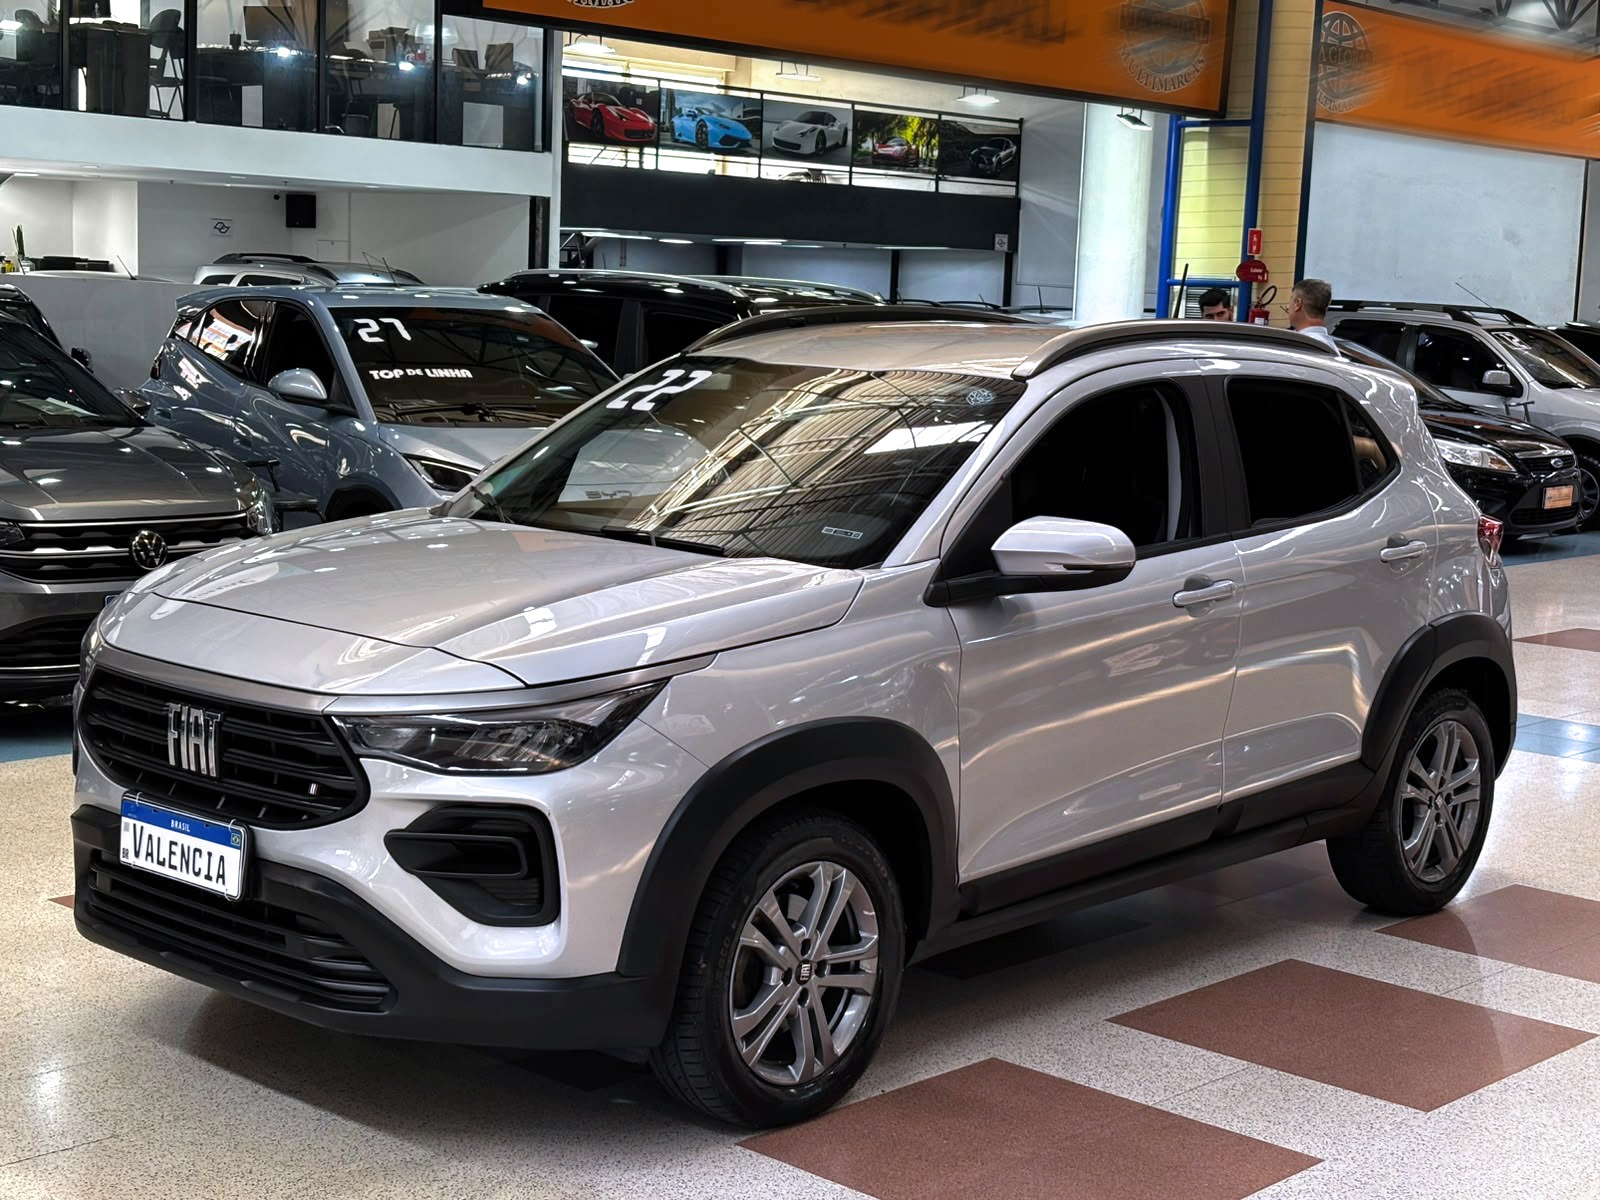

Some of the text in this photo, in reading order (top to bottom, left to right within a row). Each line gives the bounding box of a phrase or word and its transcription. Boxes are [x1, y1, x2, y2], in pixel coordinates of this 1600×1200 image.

[1120, 44, 1206, 91] MULTIMARCAS
[353, 318, 412, 342] 27
[369, 369, 404, 380] TOP
[424, 368, 473, 378] LINHA
[606, 369, 713, 411] 22
[167, 702, 221, 777] FIAT
[170, 819, 190, 833] BRASIL
[122, 847, 129, 859] BR
[133, 823, 226, 886] VALENCIA
